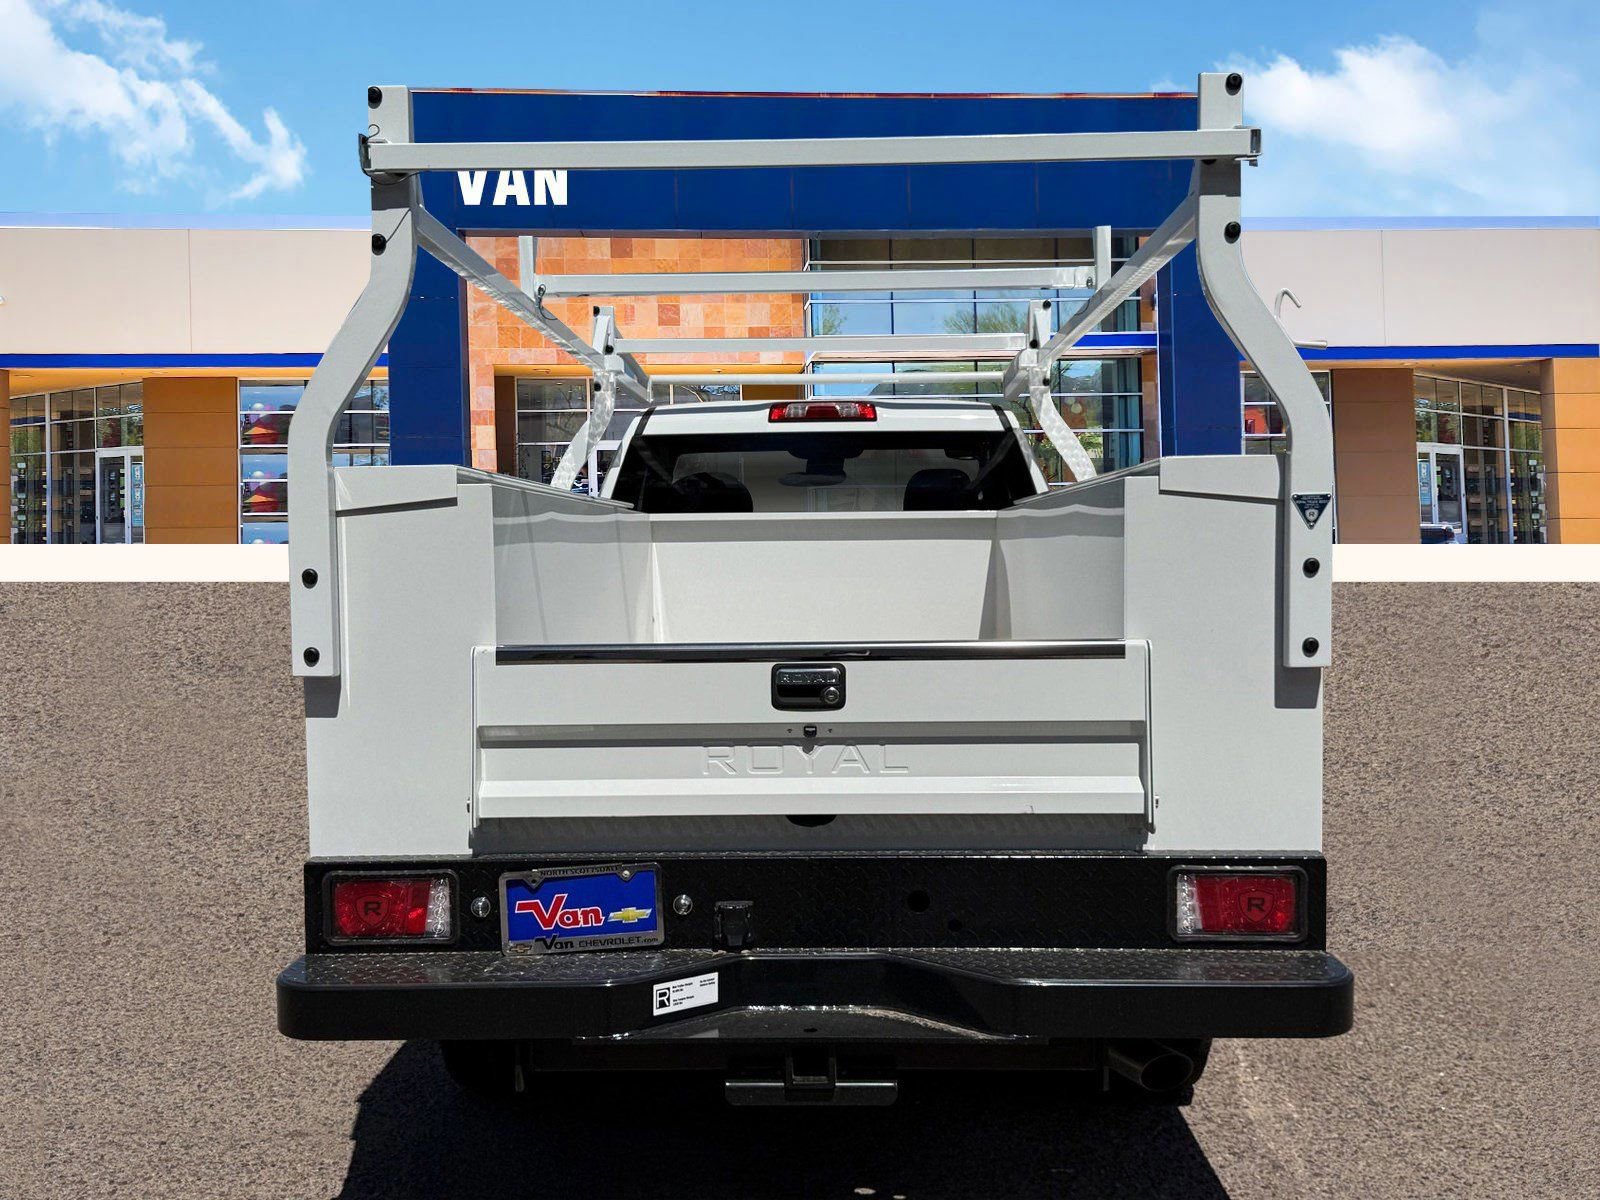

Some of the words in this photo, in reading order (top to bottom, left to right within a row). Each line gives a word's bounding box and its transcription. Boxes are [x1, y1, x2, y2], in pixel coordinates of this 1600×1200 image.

[457, 170, 568, 205] VAN
[702, 742, 909, 774] ROYAL
[363, 901, 382, 916] R
[515, 893, 606, 931] Van
[1247, 897, 1266, 913] R
[535, 934, 575, 950] Van
[656, 988, 670, 1009] R
